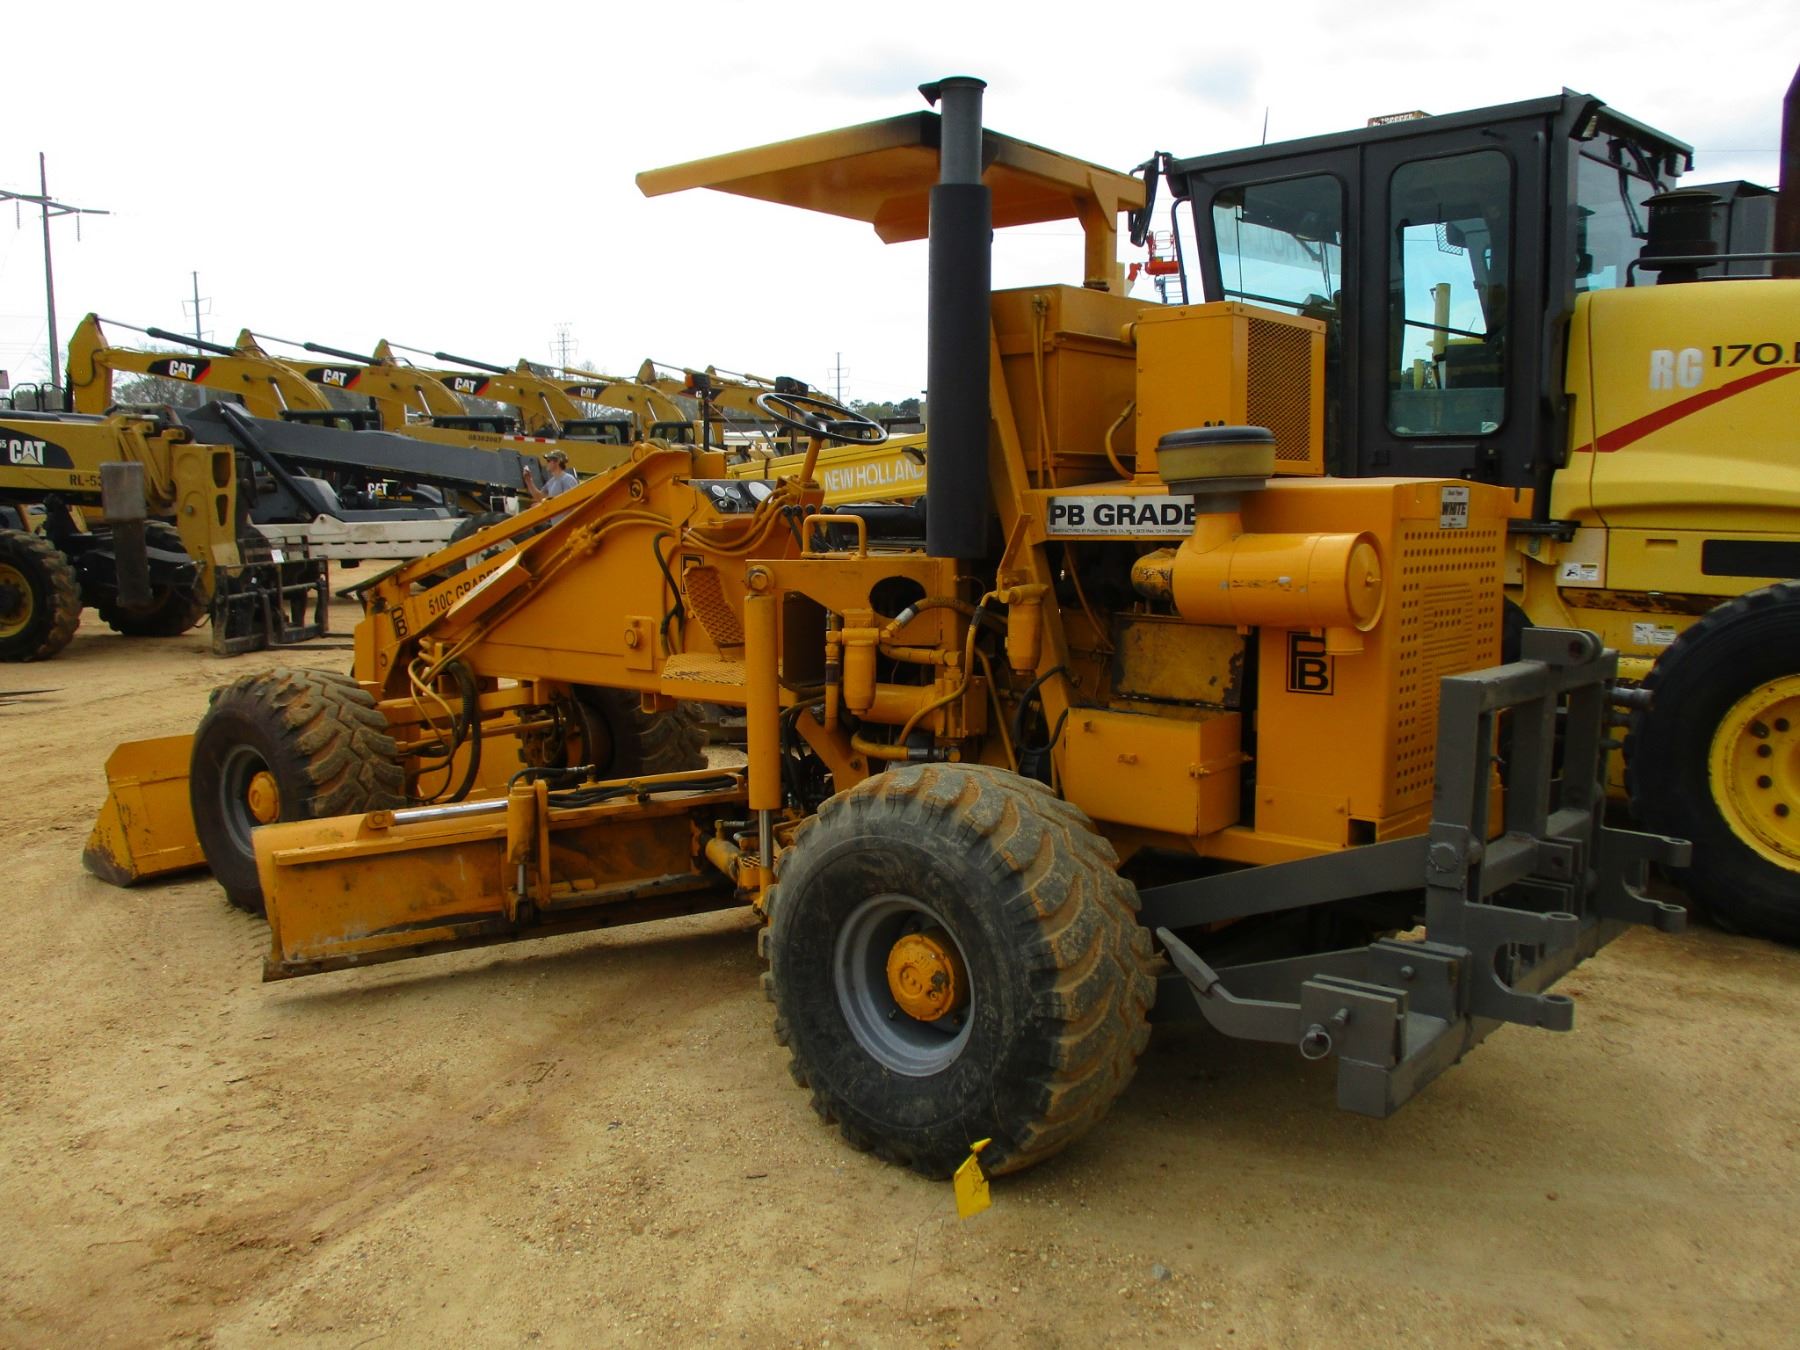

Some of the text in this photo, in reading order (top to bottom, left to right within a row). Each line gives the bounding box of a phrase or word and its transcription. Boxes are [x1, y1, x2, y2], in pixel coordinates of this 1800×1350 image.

[168, 360, 195, 380] CAT
[323, 369, 347, 386] CAT
[1649, 348, 1703, 390] RG
[454, 378, 477, 394] CAT
[580, 387, 597, 399] CAT
[10, 440, 46, 465] CAT
[825, 459, 925, 493] NEW HOLLAND
[1050, 505, 1085, 526] PB
[429, 590, 453, 616] 510C
